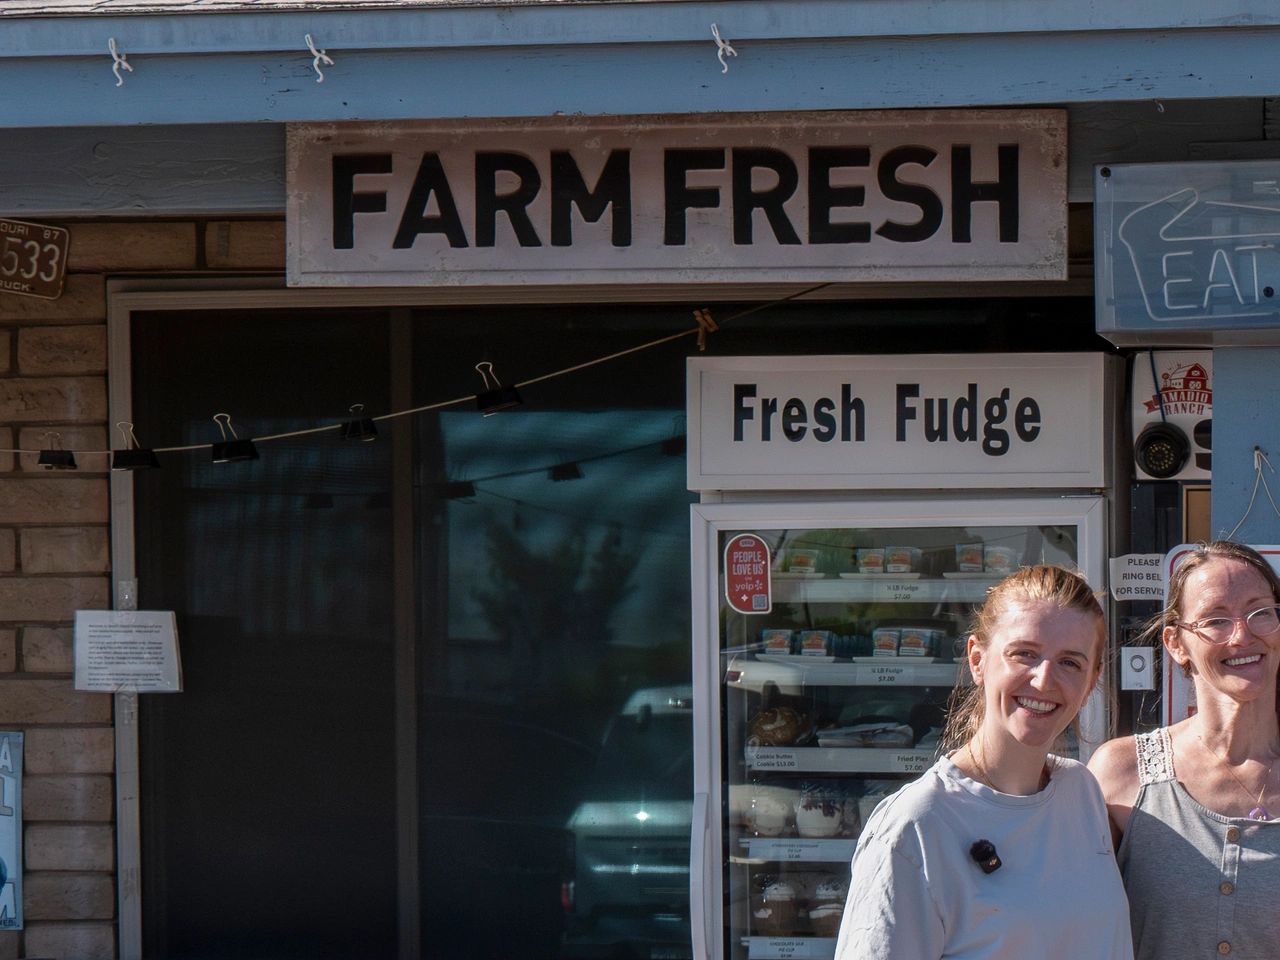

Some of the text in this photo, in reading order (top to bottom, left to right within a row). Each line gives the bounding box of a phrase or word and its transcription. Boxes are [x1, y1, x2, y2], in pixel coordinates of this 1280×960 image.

[332, 144, 1019, 250] FARM FRESH
[43, 229, 60, 240] 87
[1162, 243, 1275, 310] EAT
[1163, 402, 1205, 416] RANCH
[733, 383, 1042, 457] Fresh Fudge
[733, 551, 762, 563] PEOPLE
[1127, 558, 1160, 567] PLEASE
[732, 563, 764, 576] LOVE US
[1122, 573, 1144, 581] RING
[1116, 587, 1133, 595] FOR
